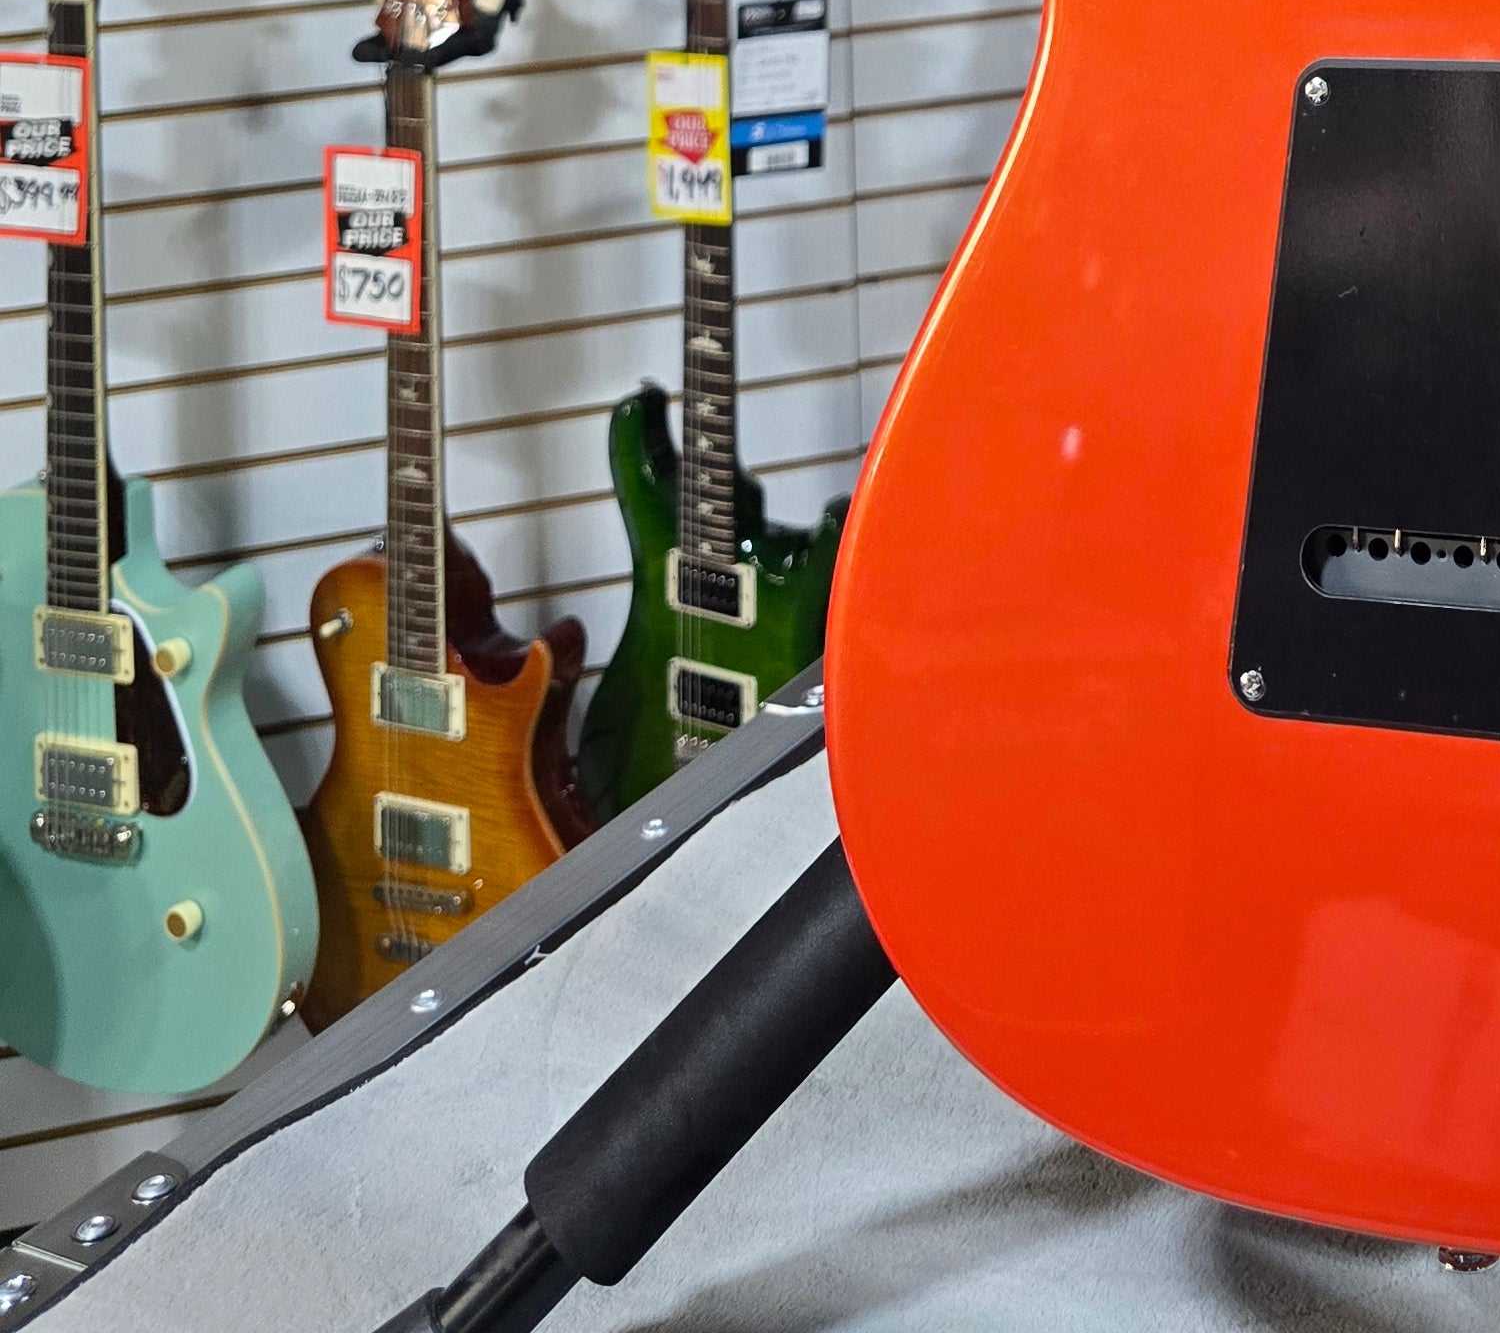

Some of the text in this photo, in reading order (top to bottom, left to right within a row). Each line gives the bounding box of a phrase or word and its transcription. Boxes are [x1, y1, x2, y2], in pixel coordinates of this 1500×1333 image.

[12, 118, 62, 140] OUR
[4, 135, 72, 161] PRICE
[348, 209, 396, 230] OUR
[341, 226, 406, 251] PRICE
[337, 264, 406, 304] $750
